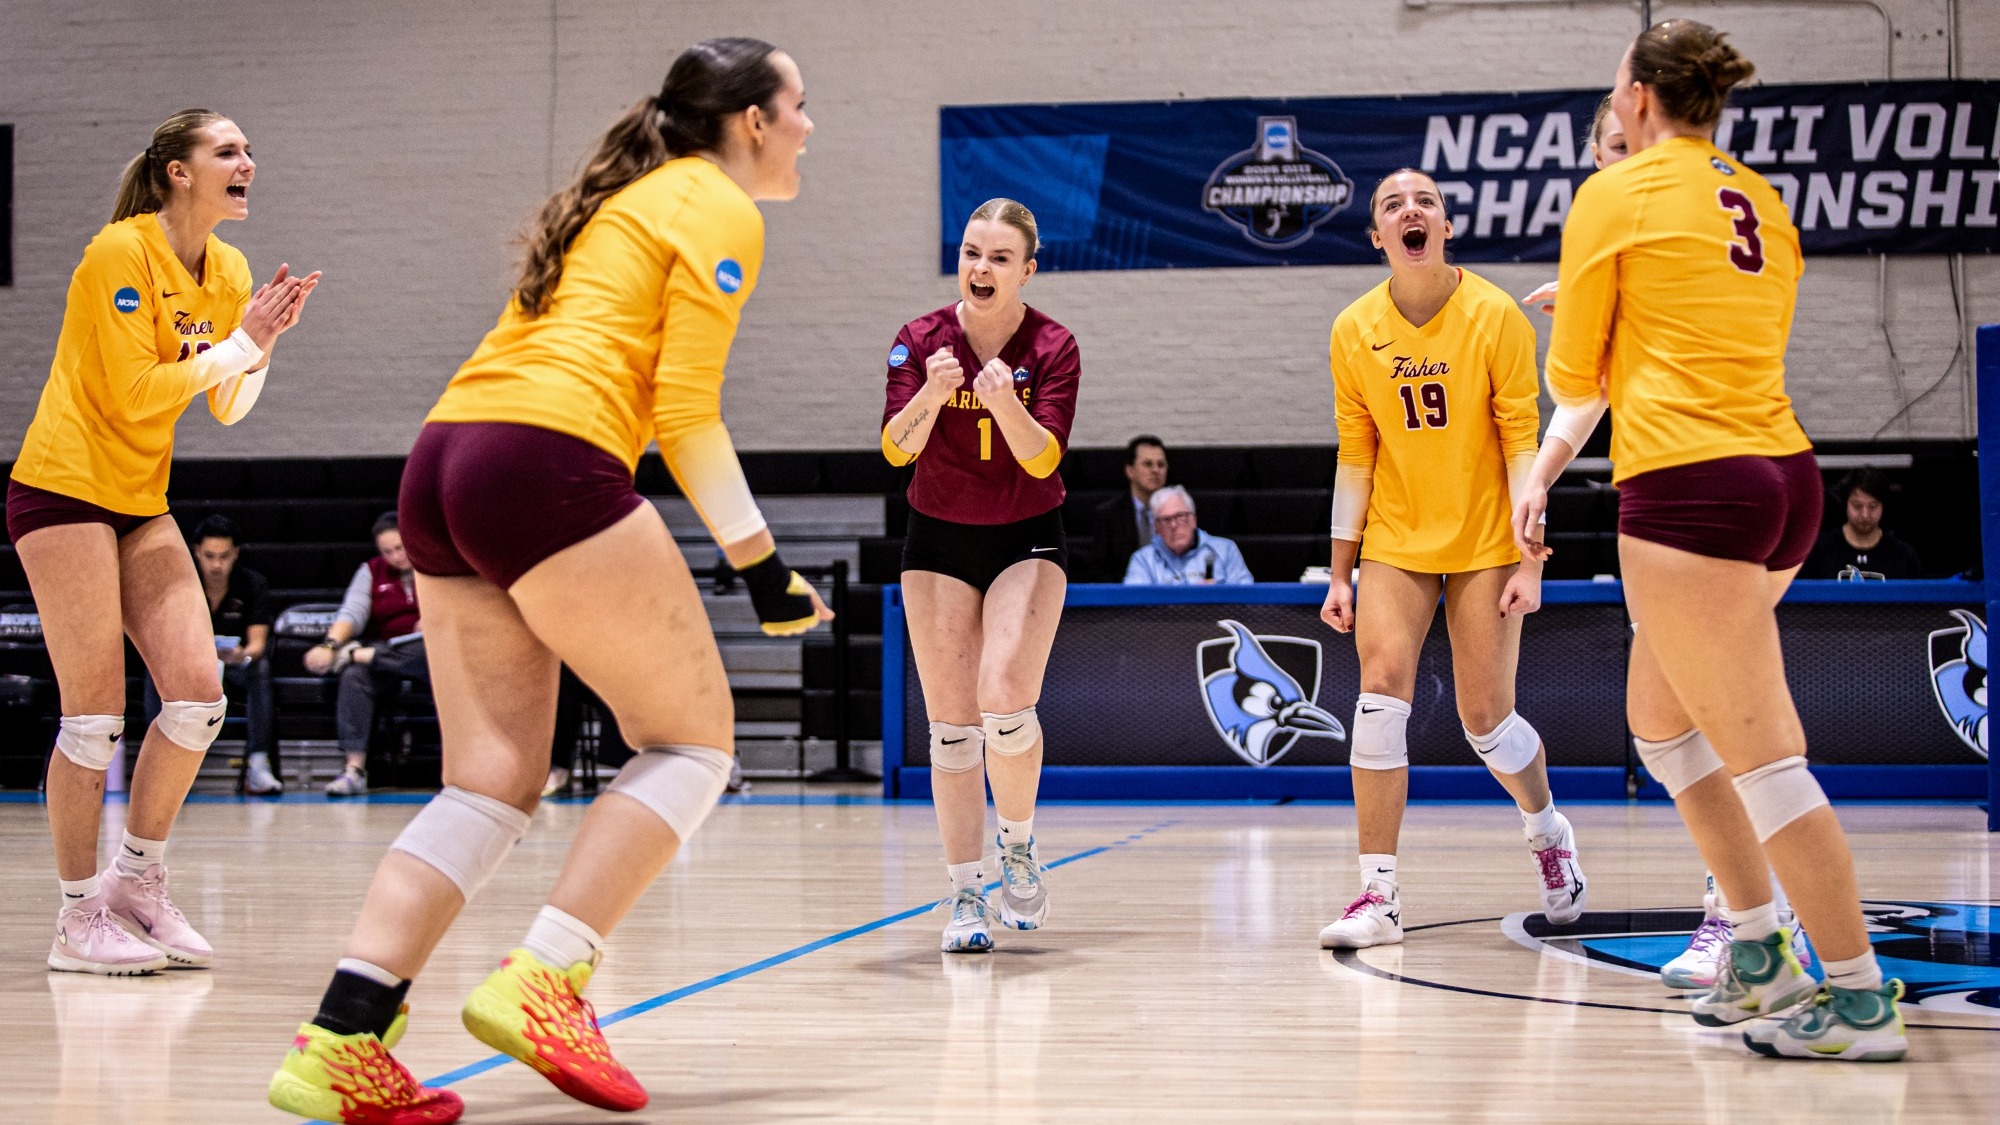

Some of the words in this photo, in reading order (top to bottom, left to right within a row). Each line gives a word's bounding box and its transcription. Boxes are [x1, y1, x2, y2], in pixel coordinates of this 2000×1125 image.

[1208, 184, 1348, 206] CHAMPIONSHIP
[1715, 186, 1765, 276] 3
[117, 298, 139, 308] NCAA
[173, 310, 215, 336] Fisher
[1389, 355, 1451, 379] Fisher
[1398, 381, 1449, 431] 19
[977, 417, 992, 461] 1
